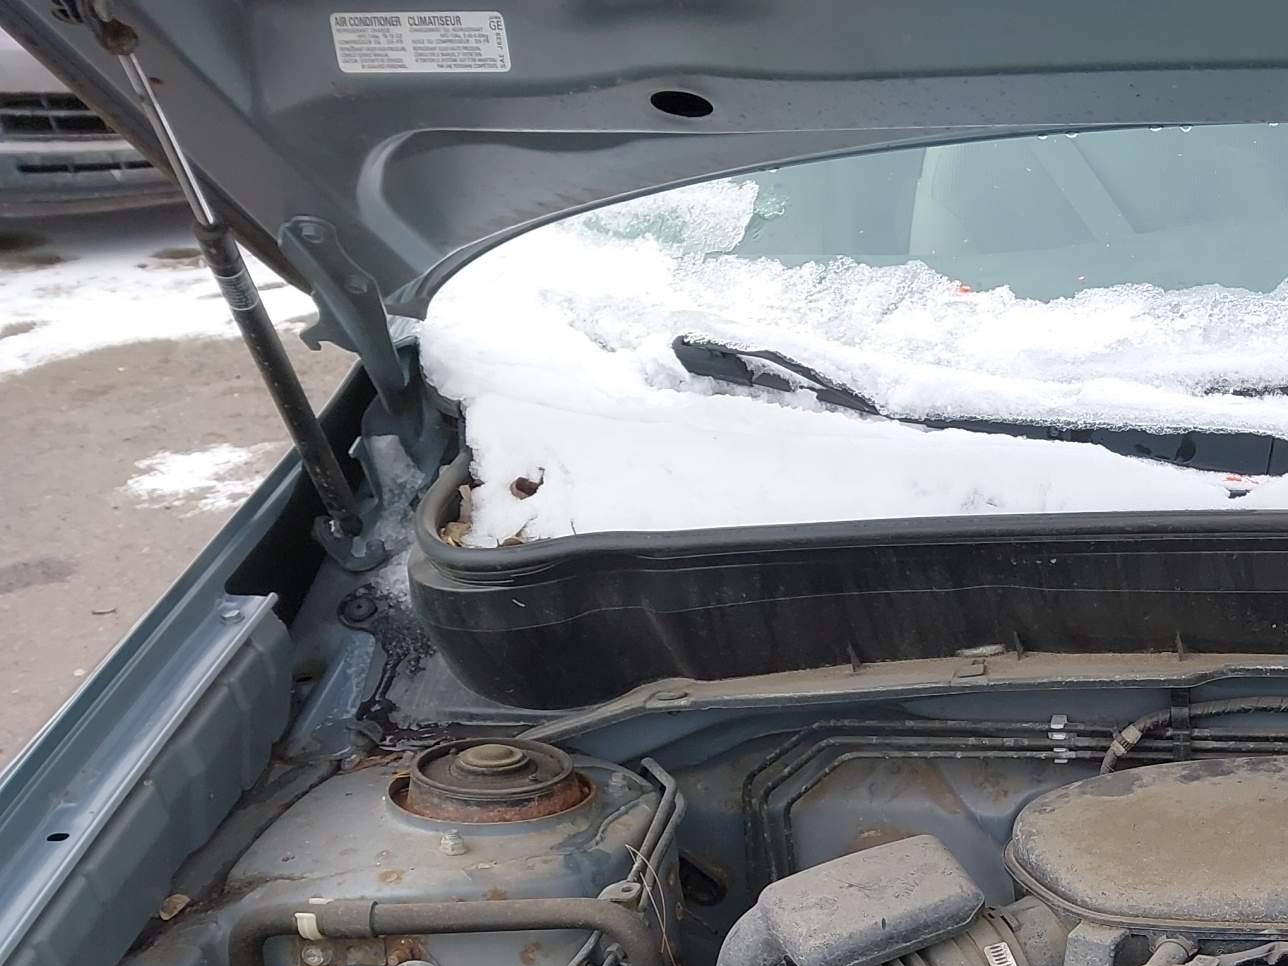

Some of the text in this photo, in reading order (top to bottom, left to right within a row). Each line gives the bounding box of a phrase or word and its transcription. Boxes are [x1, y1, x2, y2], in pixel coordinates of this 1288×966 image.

[334, 16, 401, 27] AIR CONDITIONER
[407, 15, 462, 26] CLIMATISEUR
